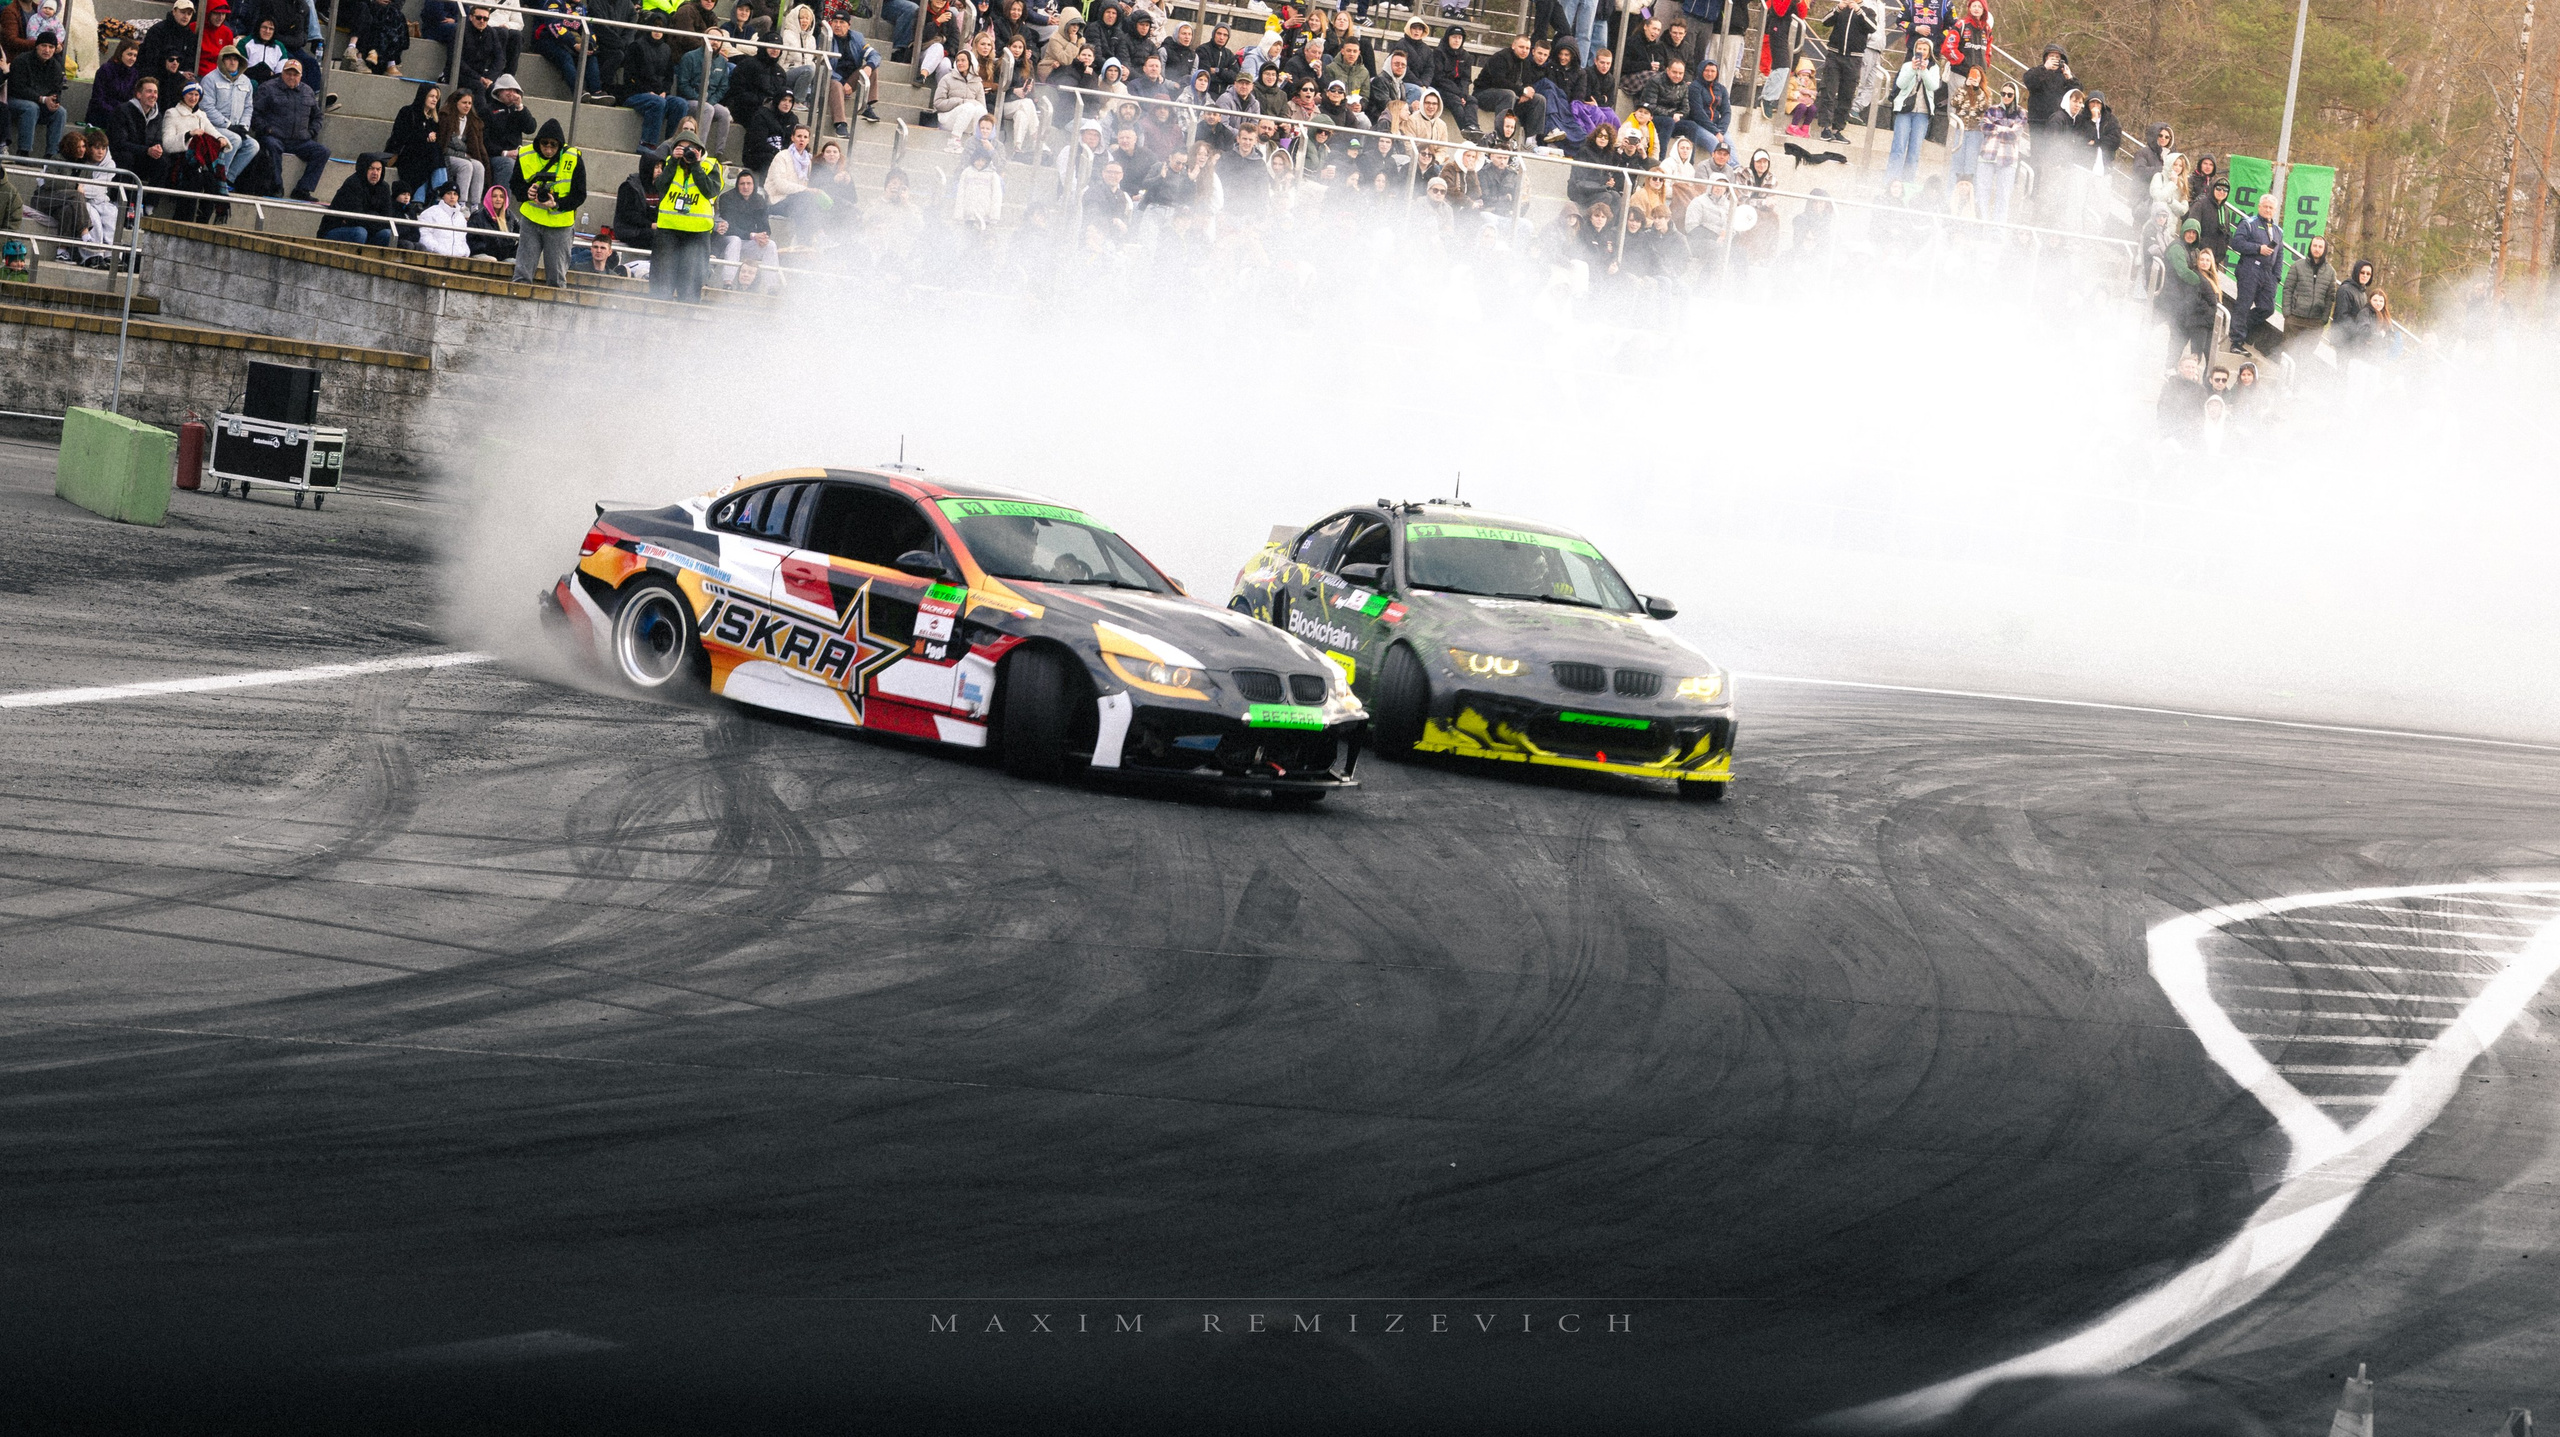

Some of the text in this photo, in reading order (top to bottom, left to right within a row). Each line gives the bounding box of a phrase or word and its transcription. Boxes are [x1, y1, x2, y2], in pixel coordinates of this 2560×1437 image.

[563, 160, 573, 170] 15
[962, 502, 985, 514] 98
[1418, 526, 1437, 537] 99
[694, 561, 732, 583] КОМПАНИЯ
[927, 589, 963, 603] BETERA
[1288, 609, 1352, 651] Blockchain
[699, 598, 857, 680] ISKRA
[1262, 710, 1316, 726] BETERA
